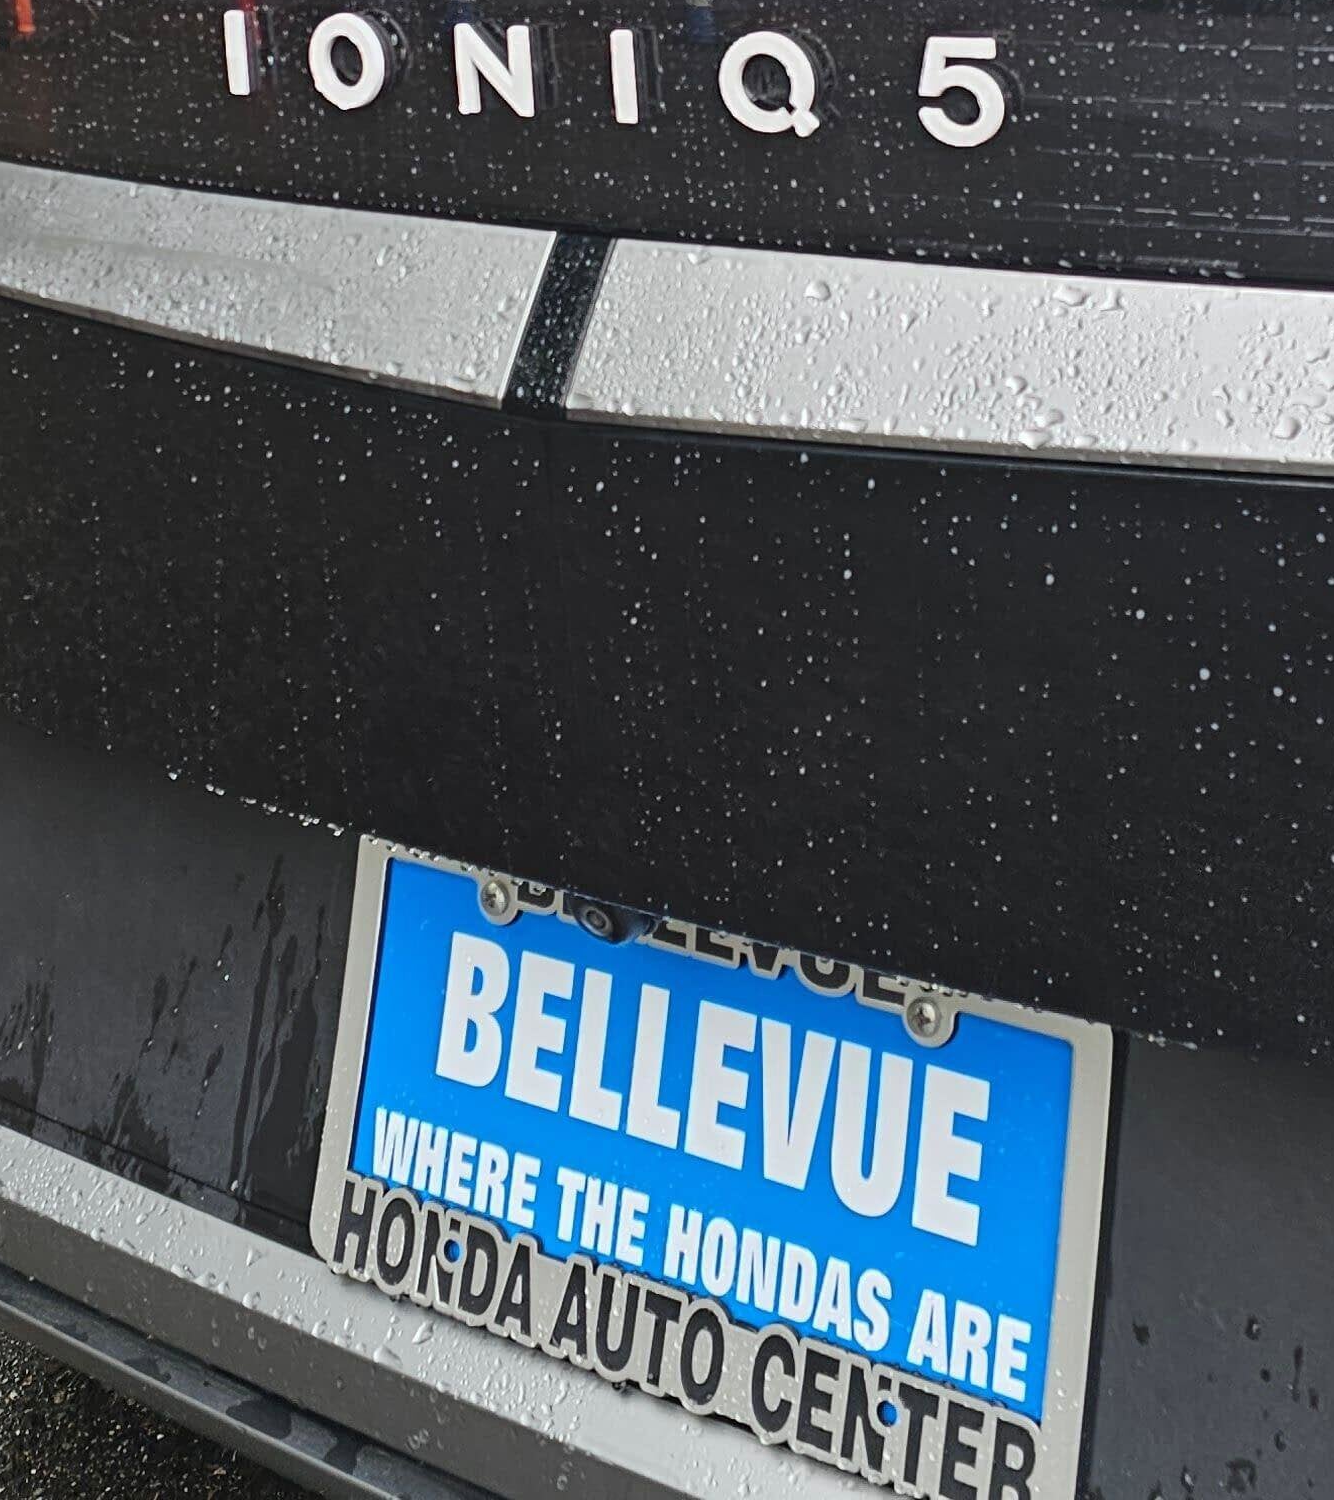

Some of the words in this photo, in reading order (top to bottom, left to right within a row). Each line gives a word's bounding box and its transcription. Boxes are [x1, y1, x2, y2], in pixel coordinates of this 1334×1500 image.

[223, 9, 820, 138] IONIQ
[917, 35, 1006, 148] 5
[434, 931, 992, 1248] BELLEVUE
[332, 1176, 533, 1338] HONDA
[548, 1262, 725, 1406] AUTO
[750, 1333, 1037, 1500] CENTER
[372, 1106, 542, 1229] WHERE
[556, 1165, 650, 1267] THE
[663, 1203, 893, 1352] HONDAS
[906, 1288, 1032, 1402] ARE
